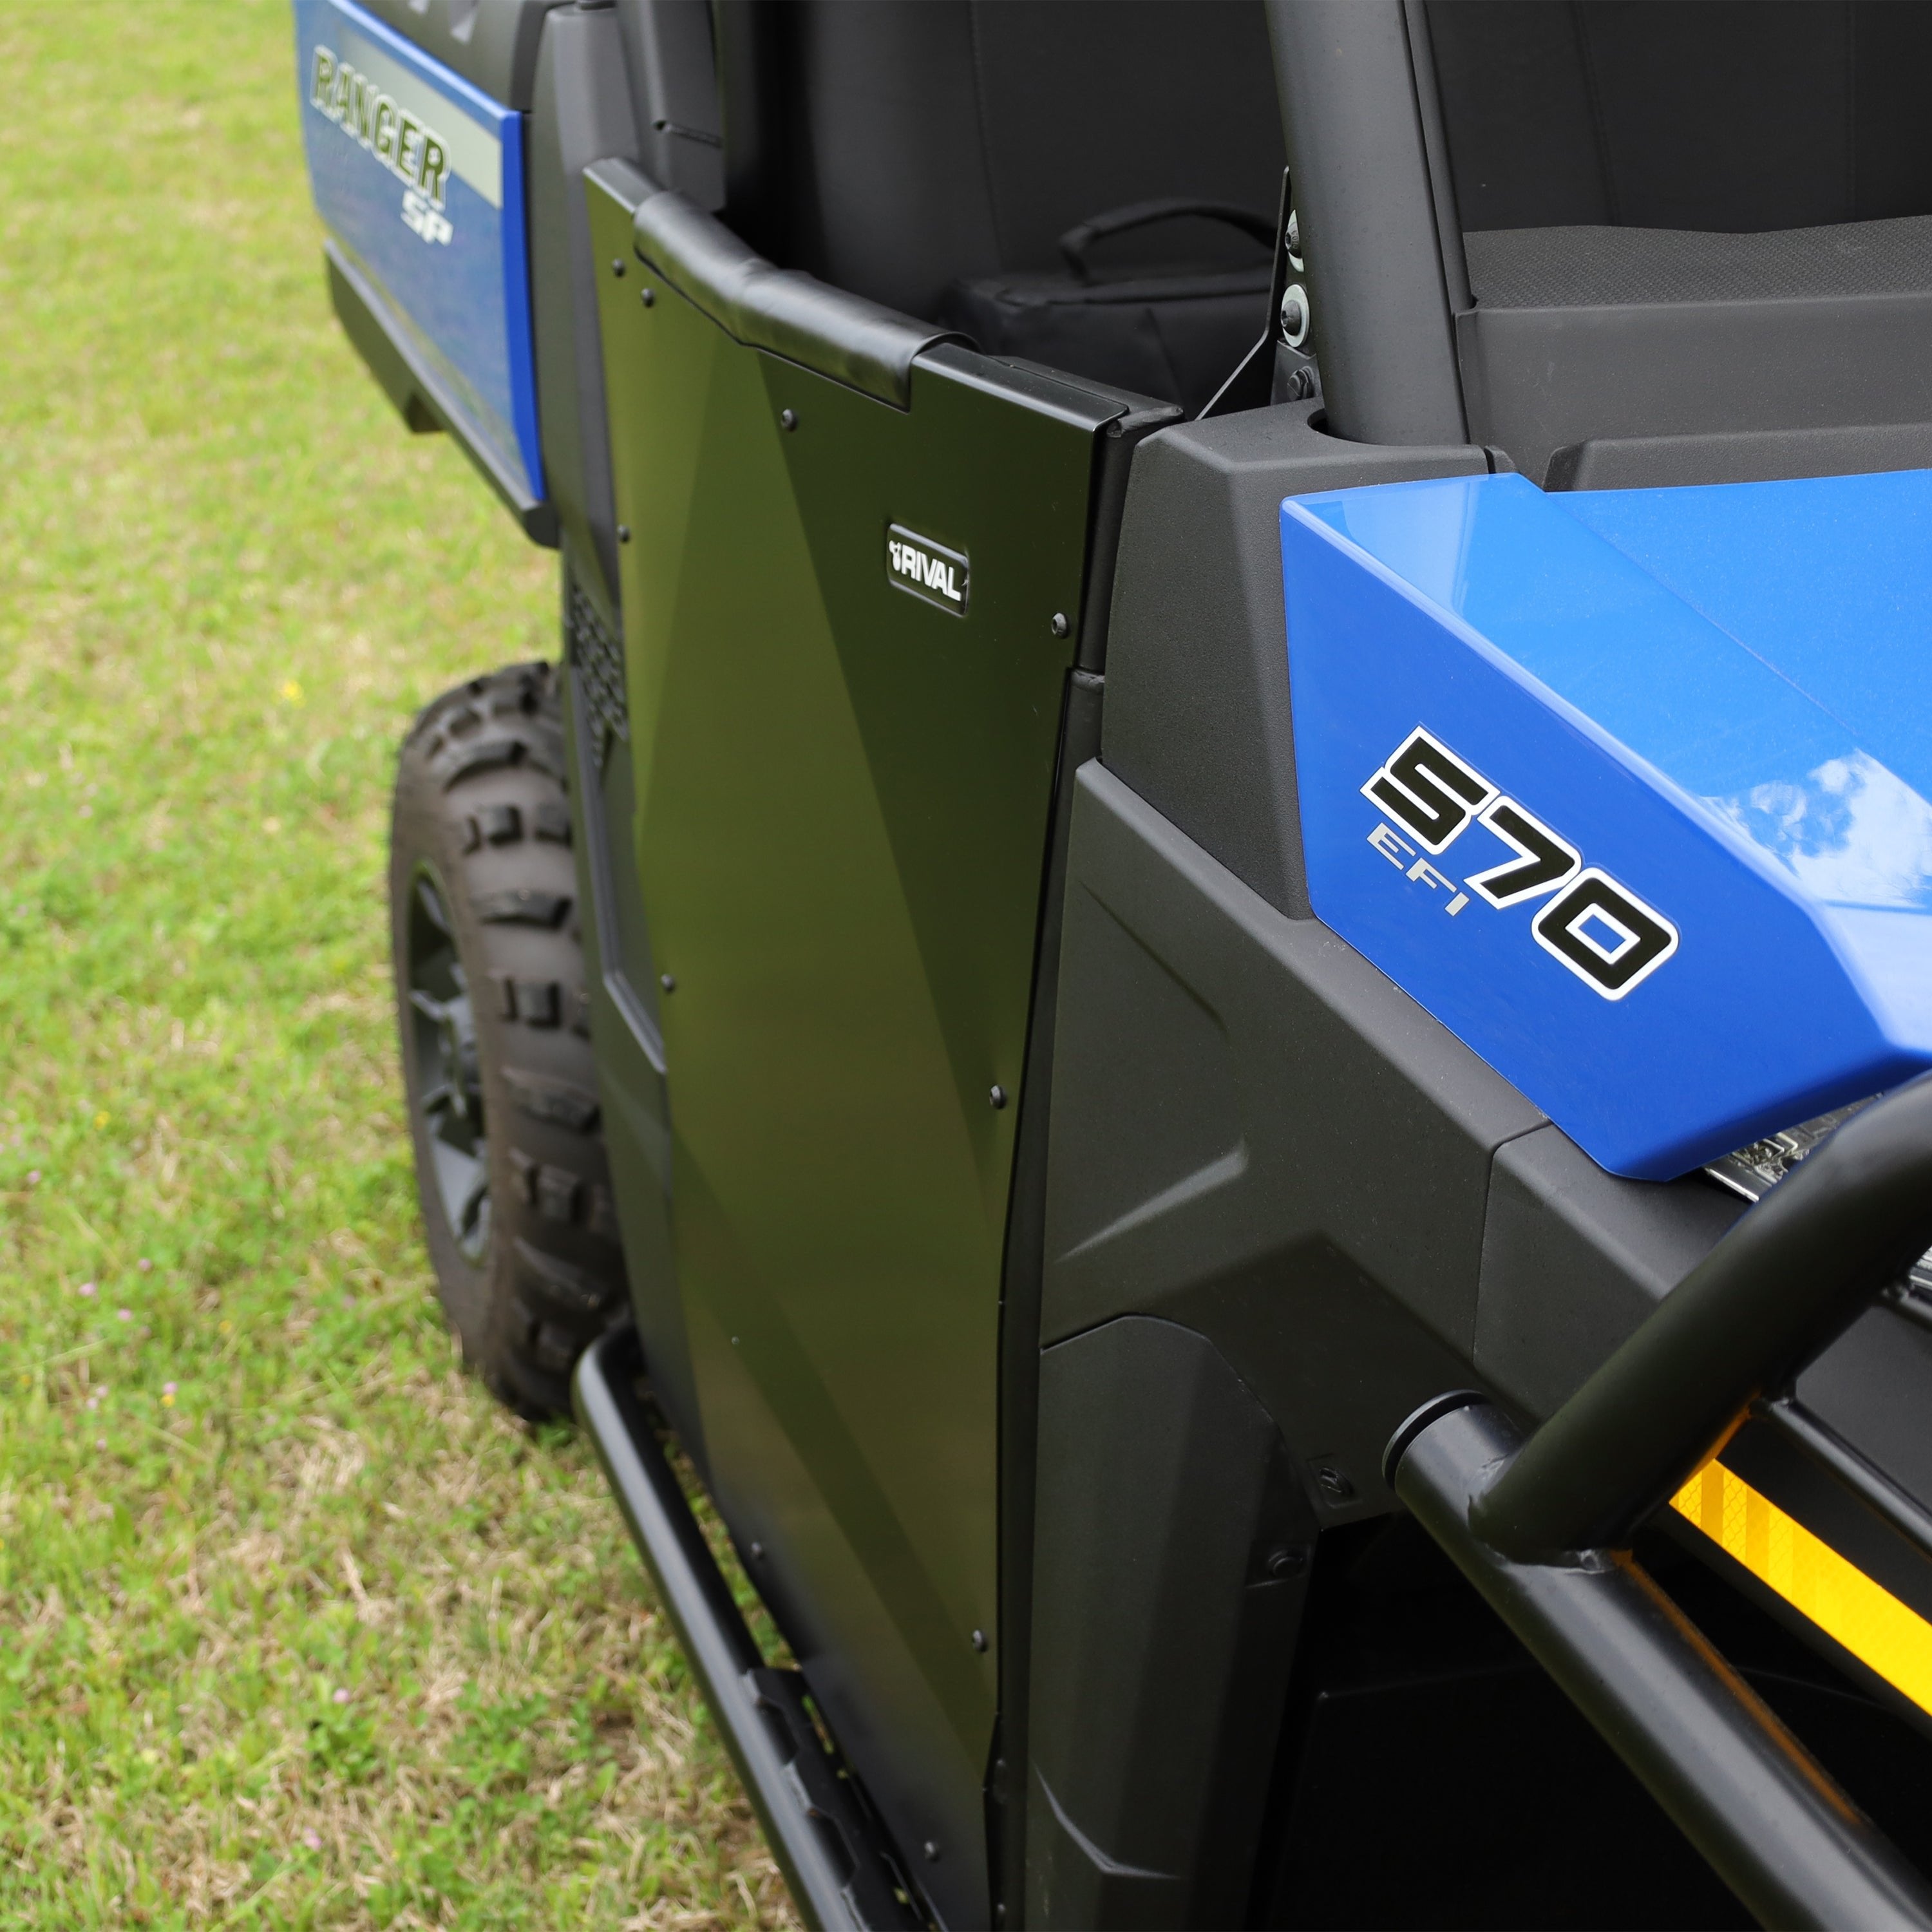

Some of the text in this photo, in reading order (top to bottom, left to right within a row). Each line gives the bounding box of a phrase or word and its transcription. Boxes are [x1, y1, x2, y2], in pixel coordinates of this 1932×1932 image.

[310, 44, 451, 213] RANGER
[401, 189, 453, 245] SP
[901, 544, 961, 601] RIVAL
[1359, 726, 1680, 1001] 570
[1367, 822, 1470, 916] EFI
